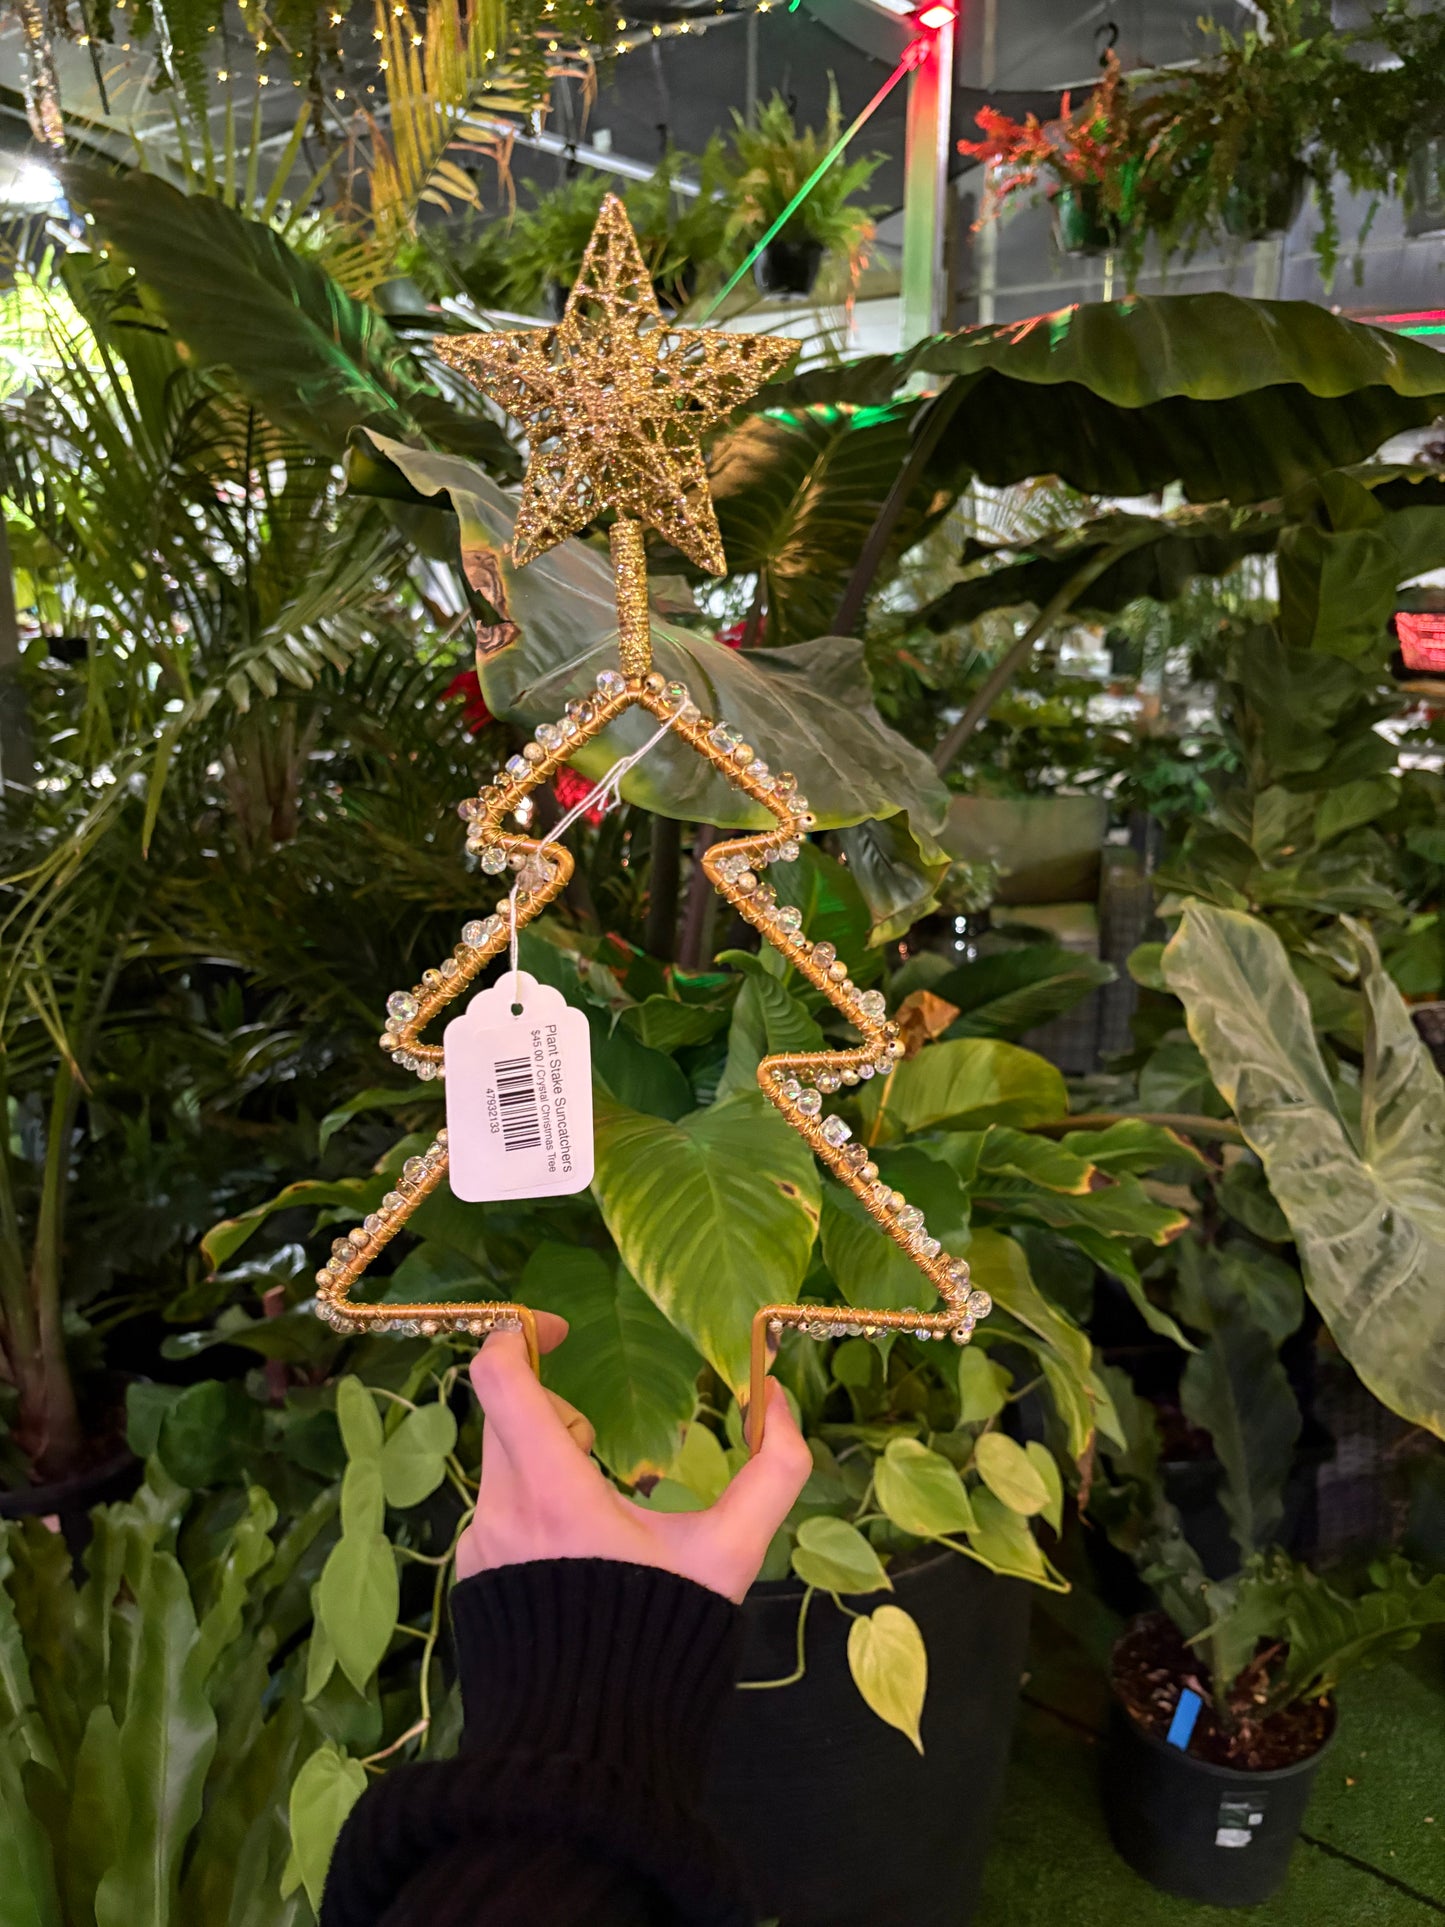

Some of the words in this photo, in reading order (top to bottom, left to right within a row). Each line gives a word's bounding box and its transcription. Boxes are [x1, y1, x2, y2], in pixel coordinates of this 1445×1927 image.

[545, 1024, 558, 1056] Plant
[536, 1069, 549, 1103] Crystal
[549, 1059, 563, 1094] Stake
[486, 1088, 500, 1134] 47932133
[540, 1105, 554, 1151] Christmas
[554, 1097, 573, 1173] Suncatchers
[546, 1153, 557, 1173] Tree
